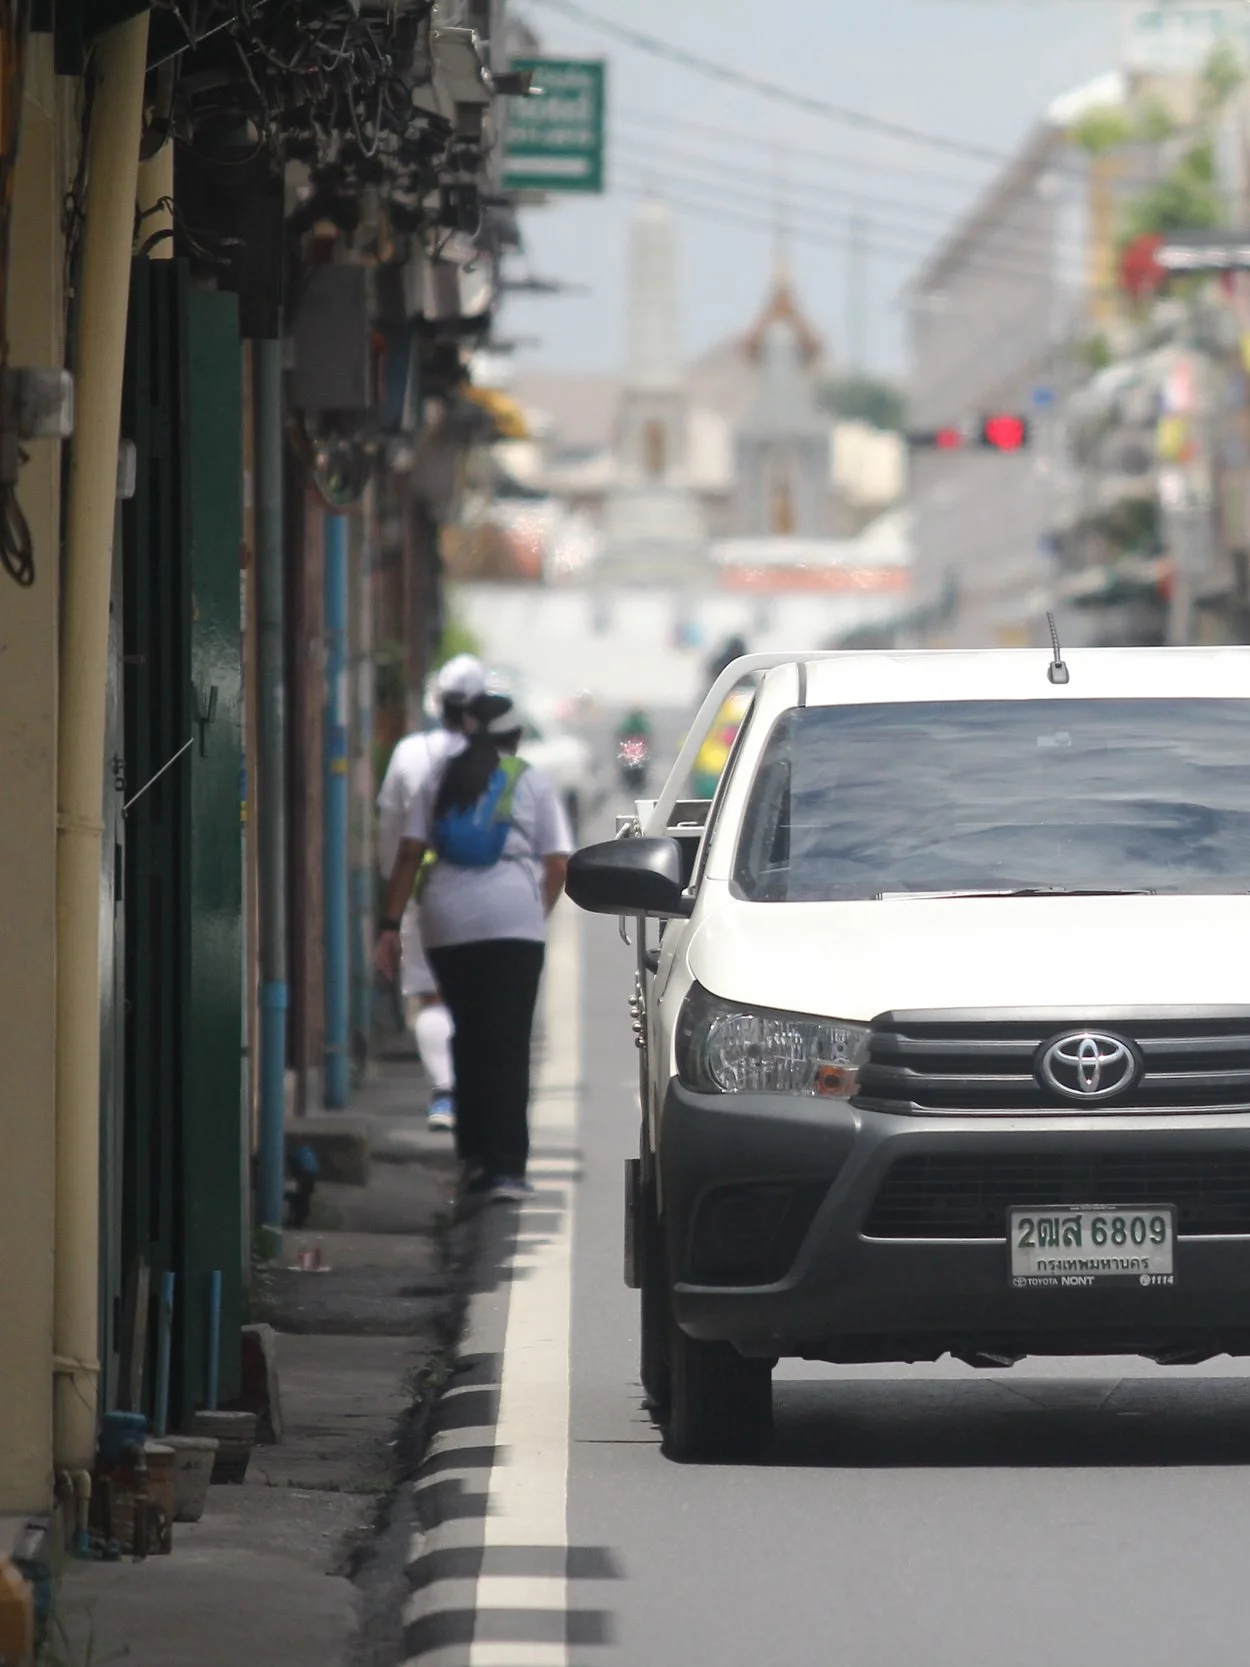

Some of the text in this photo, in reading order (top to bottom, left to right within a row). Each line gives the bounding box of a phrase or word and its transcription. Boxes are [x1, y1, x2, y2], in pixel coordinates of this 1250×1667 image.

[1091, 1215, 1167, 1246] 6809
[1037, 1256, 1150, 1275] กรุงเทพมหานคร
[1028, 1276, 1095, 1286] TOYOTA NONT
